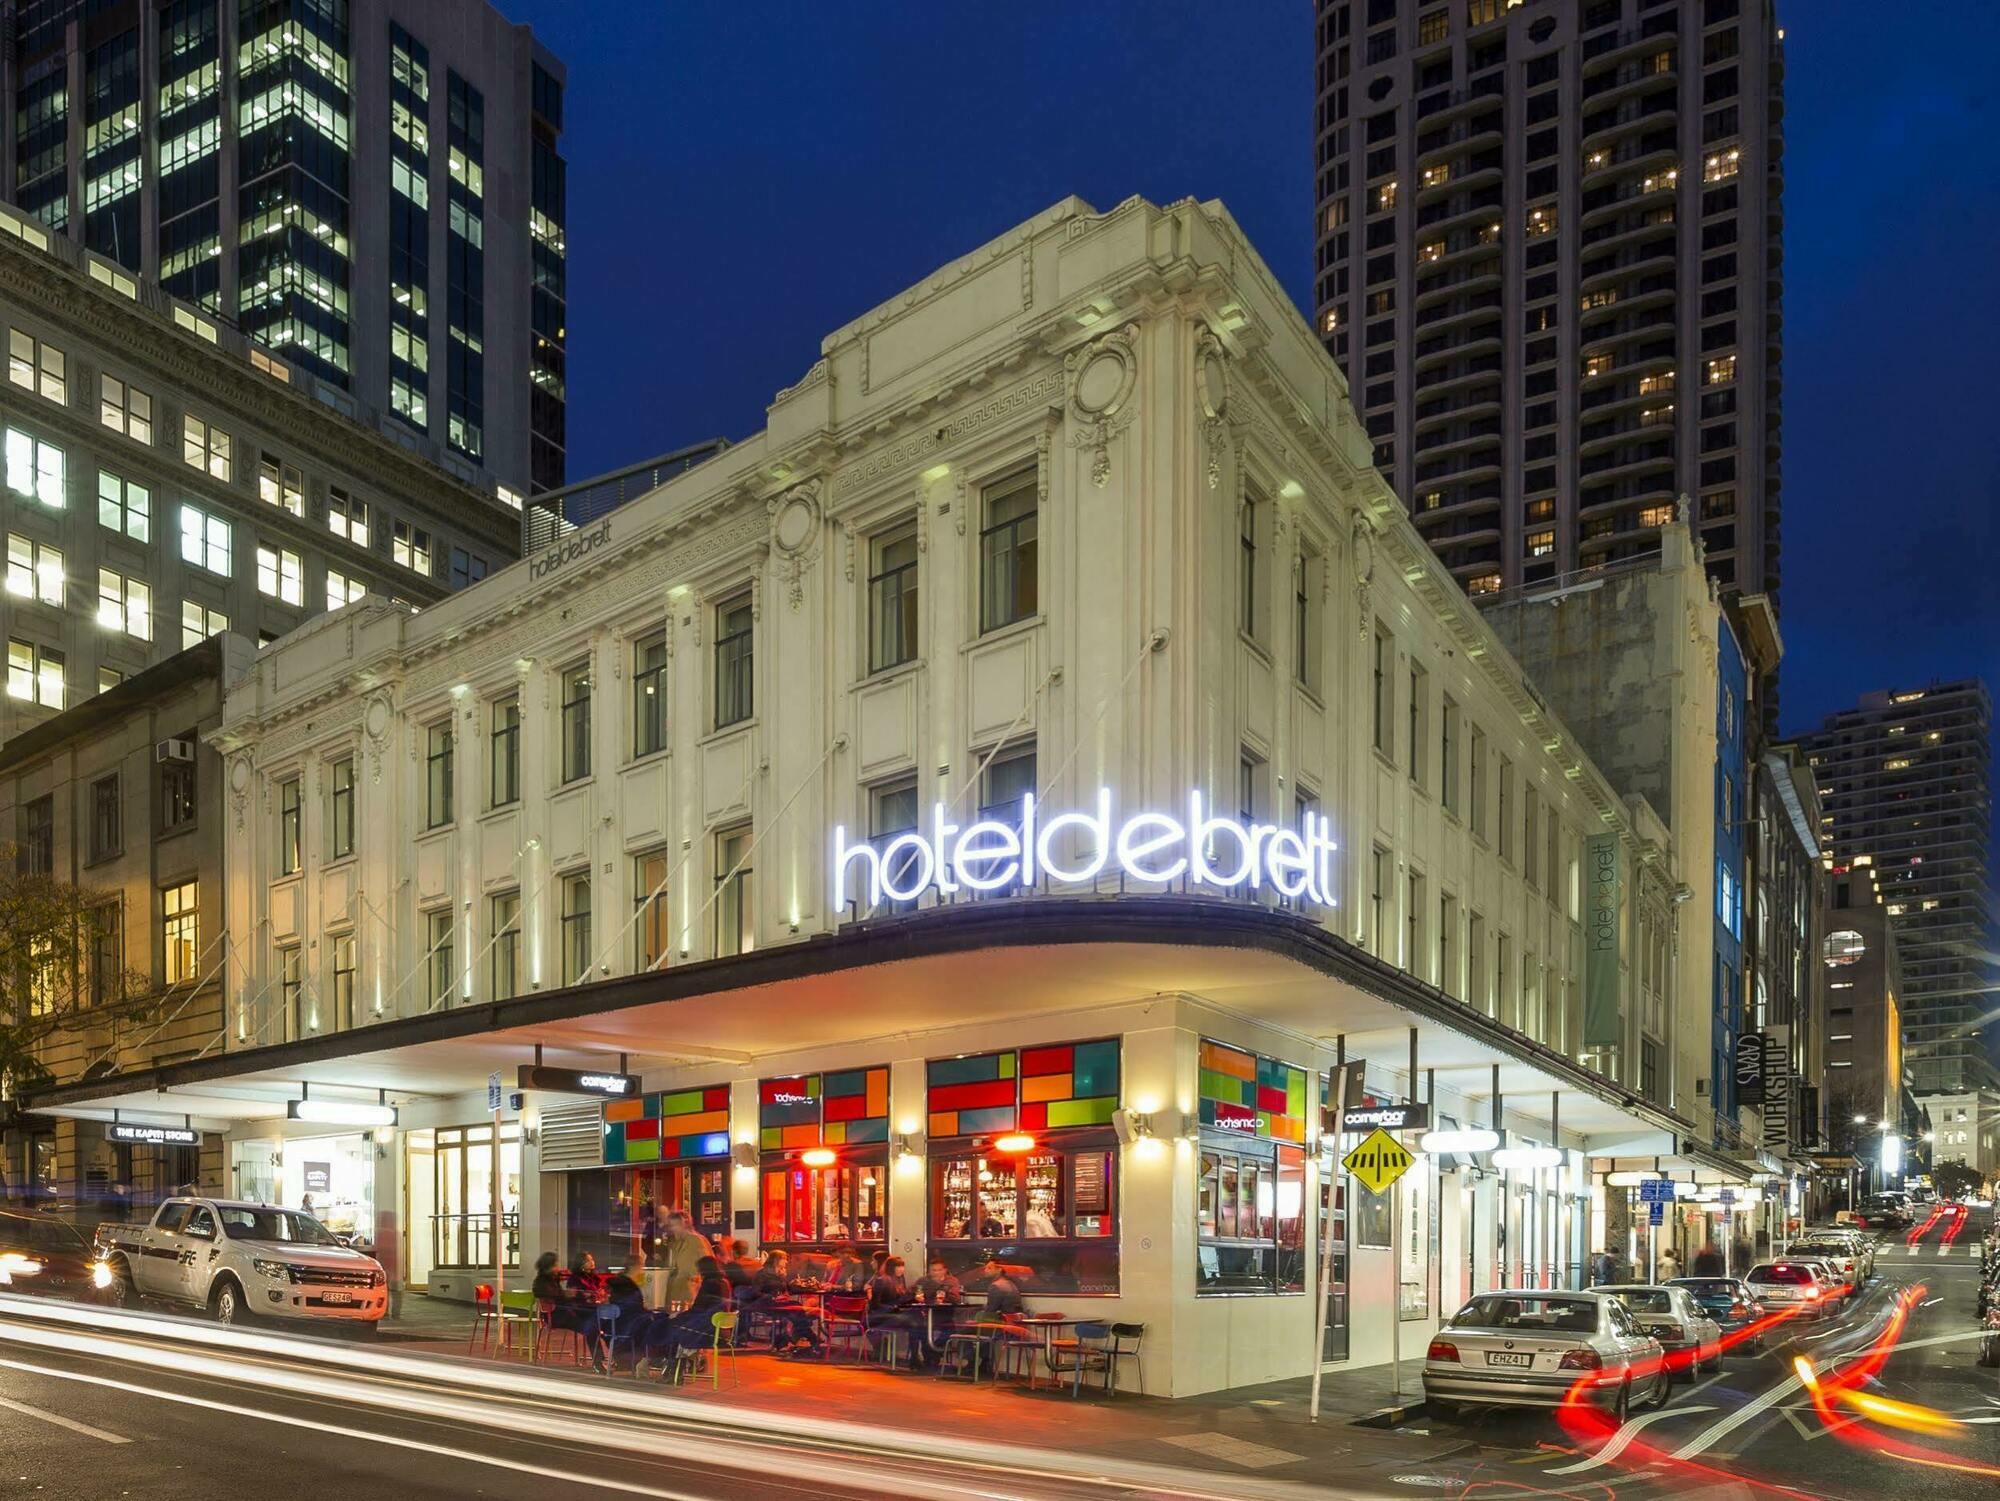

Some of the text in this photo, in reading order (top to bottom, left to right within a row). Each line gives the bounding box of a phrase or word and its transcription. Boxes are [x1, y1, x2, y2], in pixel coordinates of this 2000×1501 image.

[530, 517, 612, 582] hoteldebrett
[835, 786, 1339, 914] hoteldebrett
[1592, 842, 1615, 952] hoteldebrett
[1737, 1034, 1761, 1085] CARATS
[1344, 1110, 1406, 1124] cornerbar
[1763, 1037, 1788, 1149] WORKSHOP
[116, 1127, 193, 1142] THE KAPITI STORE
